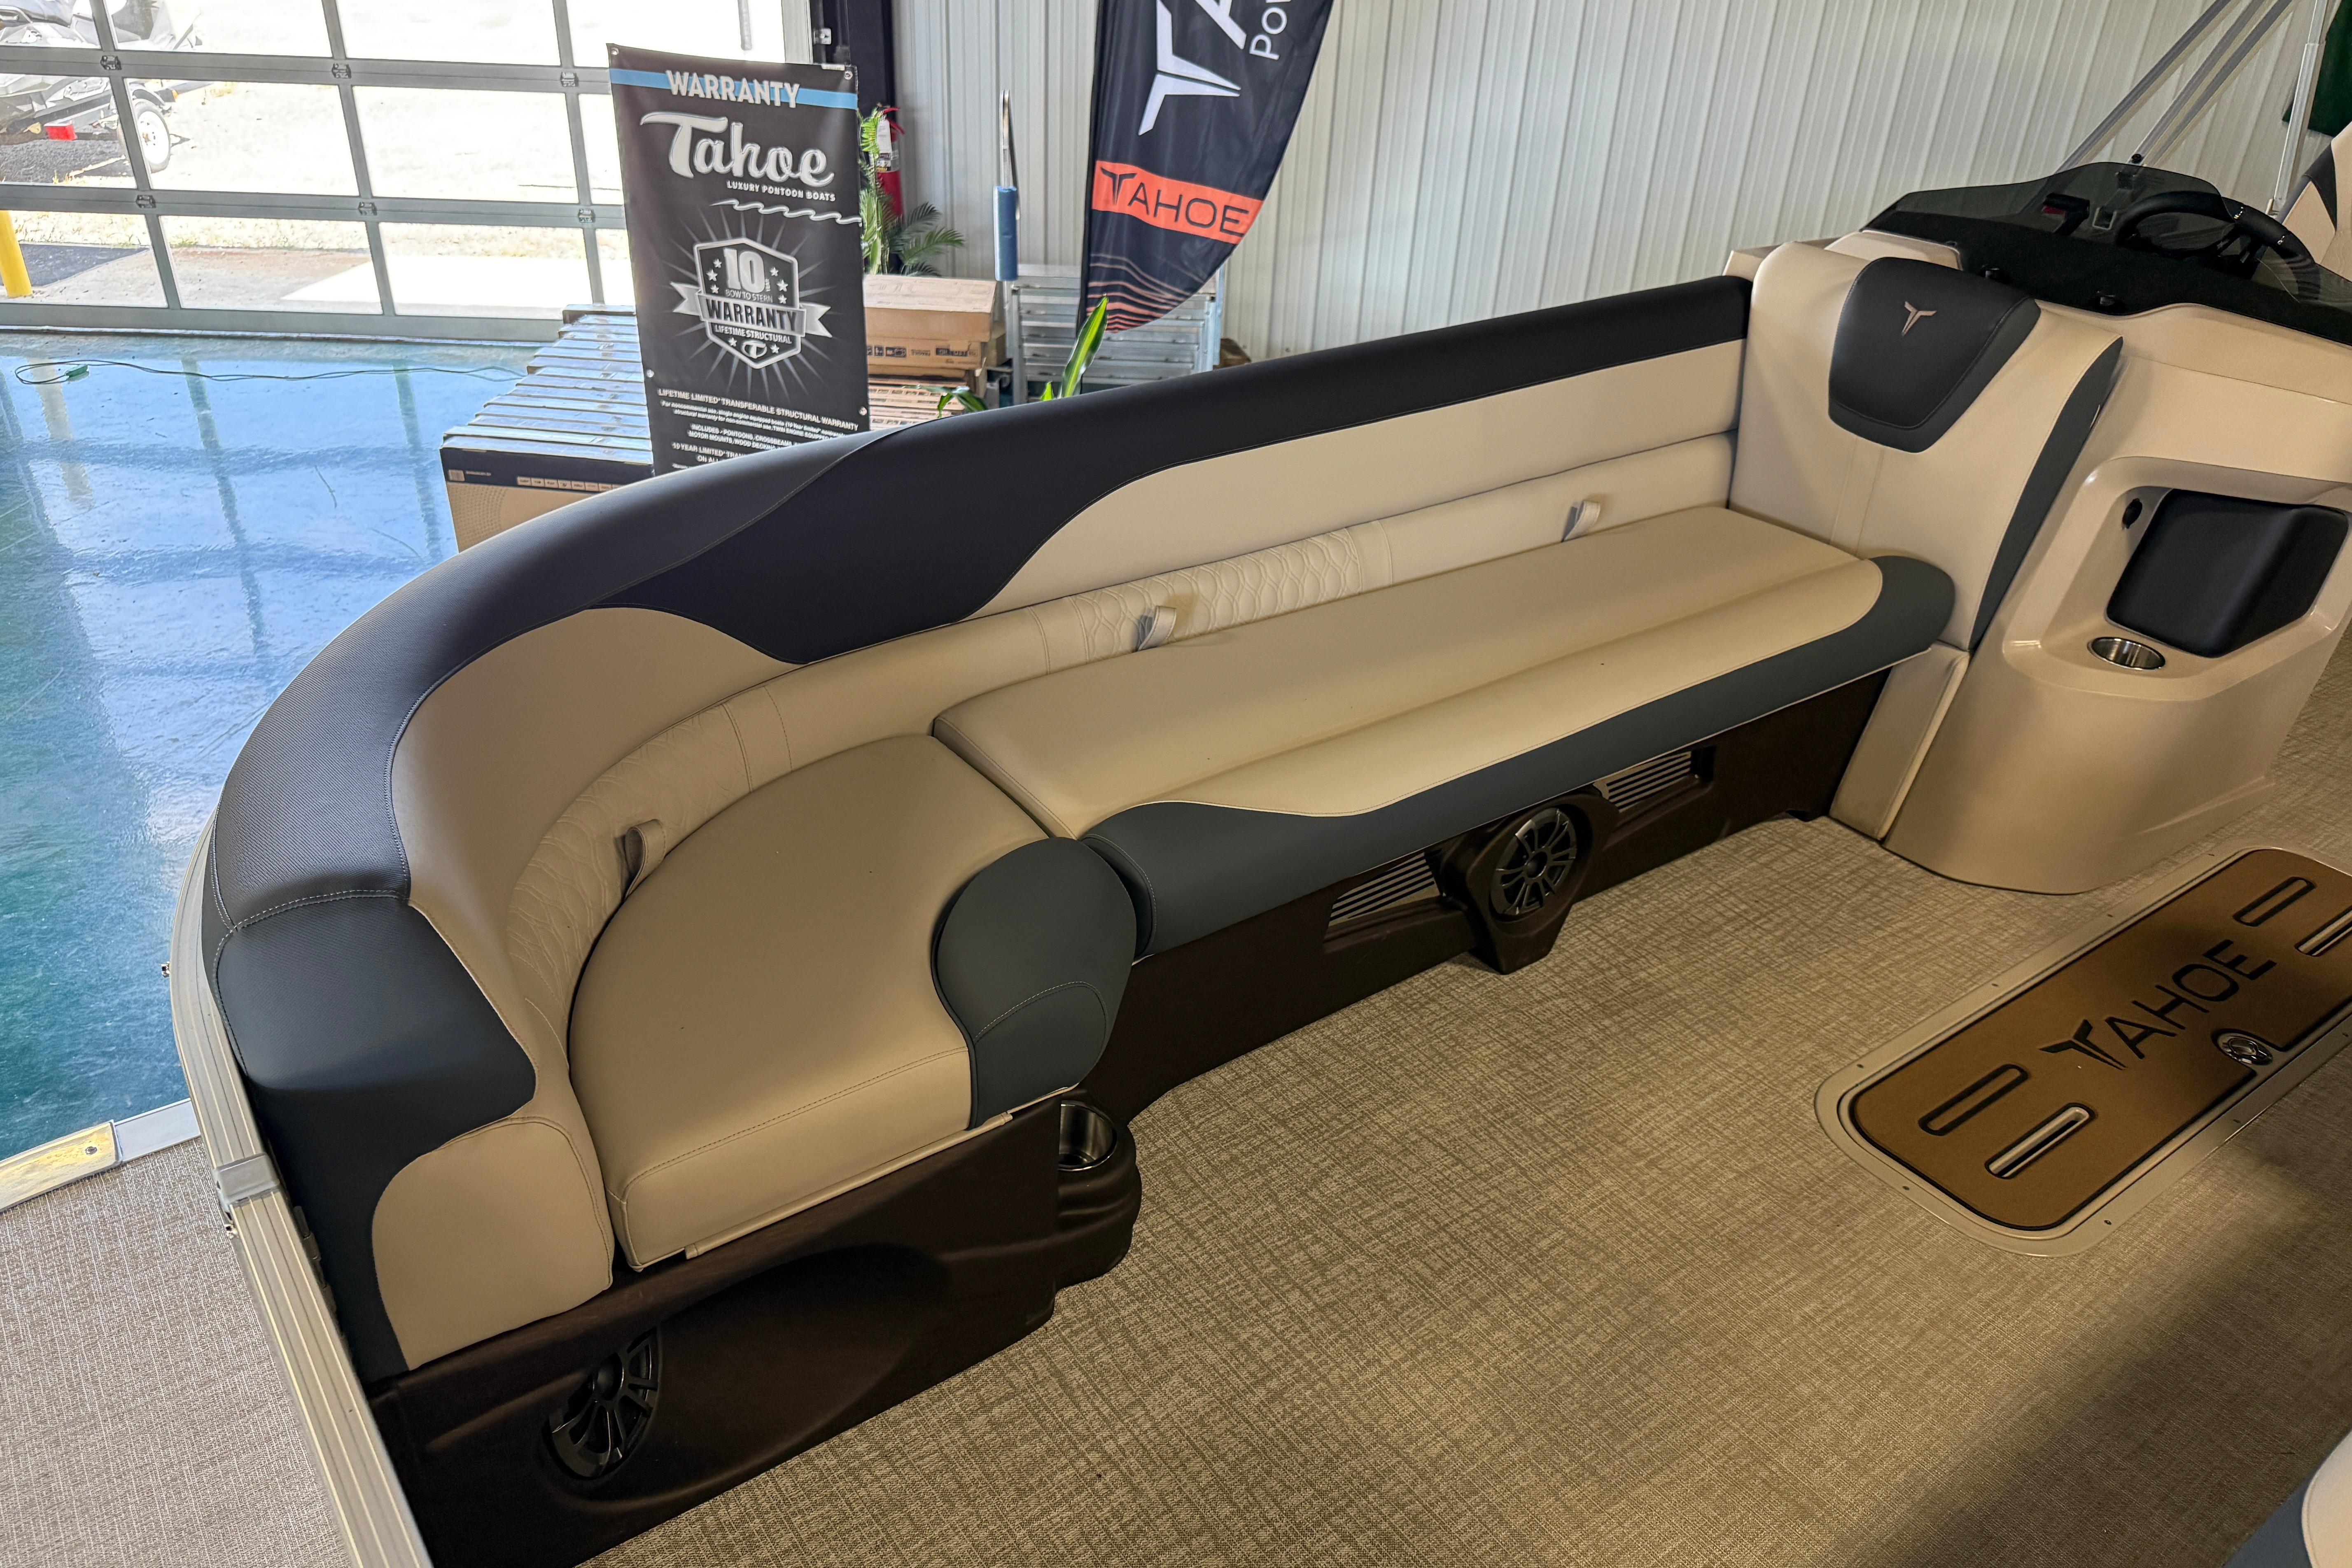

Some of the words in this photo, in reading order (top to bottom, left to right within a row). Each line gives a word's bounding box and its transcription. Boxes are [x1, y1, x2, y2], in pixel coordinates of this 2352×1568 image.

[1249, 0, 1292, 60] PO
[665, 70, 800, 108] WARRANTY
[640, 111, 835, 187] Tahoe
[726, 180, 760, 192] LUXURY
[761, 185, 804, 198] PONTOON
[805, 190, 836, 202] BOATS
[1100, 167, 1250, 238] TAHOE
[723, 248, 765, 293] 10
[725, 289, 741, 298] BOW
[741, 292, 752, 301] TO
[751, 294, 773, 303] STERN
[706, 299, 797, 331] WARRANTY
[714, 324, 746, 337] LIFETIME
[746, 330, 793, 344] STRUCTURAL
[658, 388, 690, 400] LIFETIME
[721, 397, 775, 414] TRANSFERABLE
[776, 407, 821, 424] STRUCTURAL
[821, 416, 859, 432] WARRANTY
[687, 429, 709, 439] MOTOR
[733, 437, 751, 447] WOOD
[690, 423, 719, 434] INCLUDES
[680, 443, 698, 453] YEAR
[2038, 939, 2278, 1071] TAHOE
